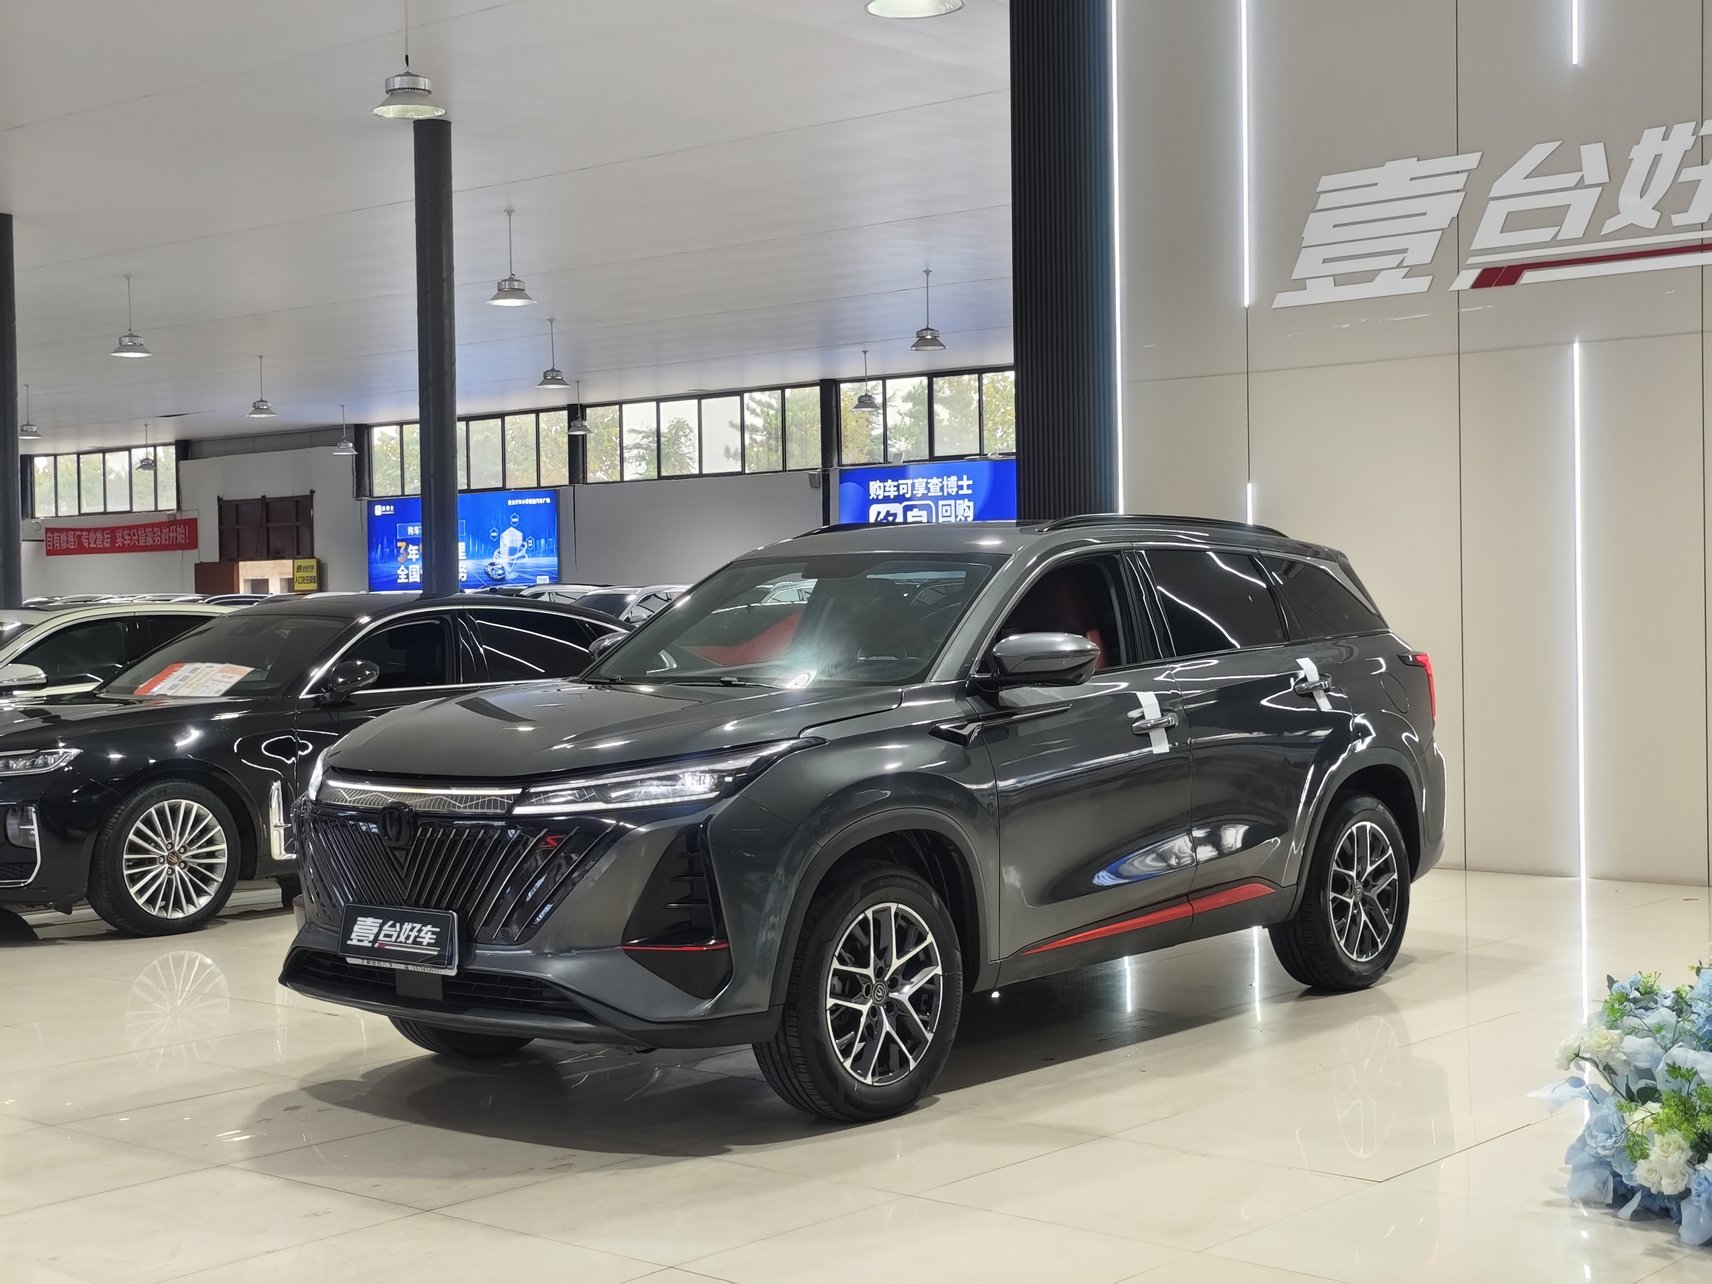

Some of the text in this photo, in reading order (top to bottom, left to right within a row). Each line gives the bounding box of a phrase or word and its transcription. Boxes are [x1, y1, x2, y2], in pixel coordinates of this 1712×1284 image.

[1271, 121, 1712, 309] 壹台好
[869, 475, 973, 499] 购车可享查博士
[46, 529, 112, 550] 自有修理厂专业售后
[407, 525, 422, 536] 购车
[396, 564, 422, 583] 全国
[346, 916, 441, 947] 壹台好车
